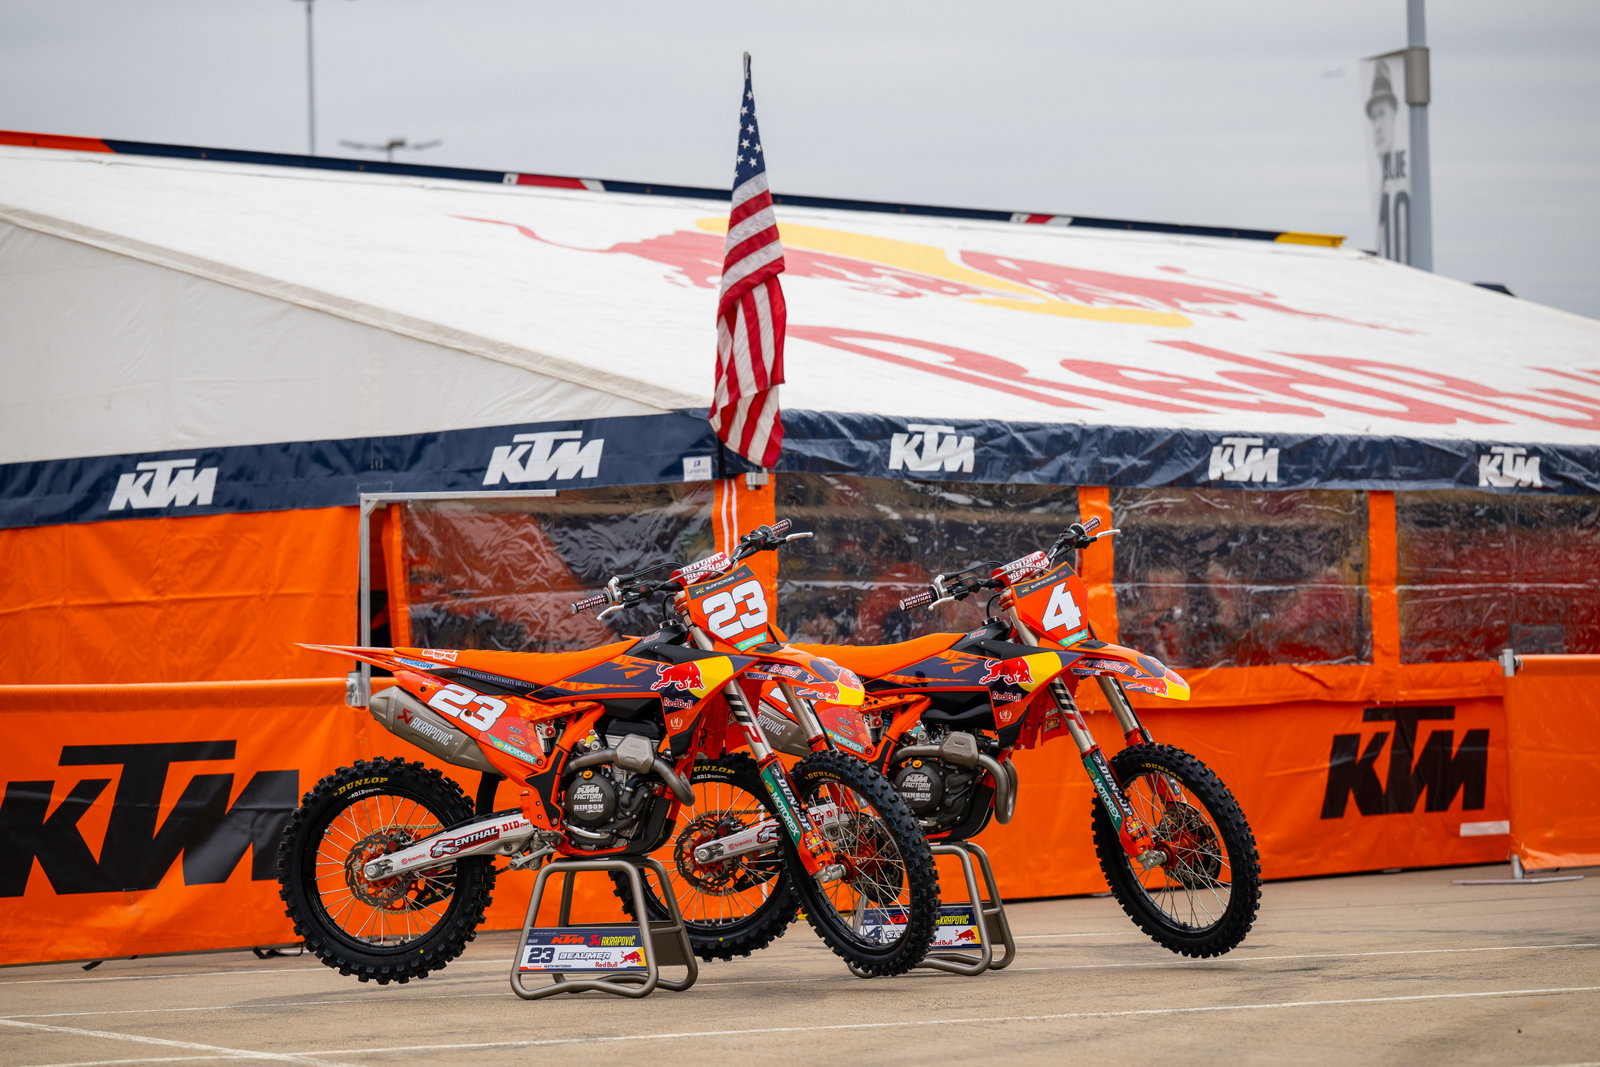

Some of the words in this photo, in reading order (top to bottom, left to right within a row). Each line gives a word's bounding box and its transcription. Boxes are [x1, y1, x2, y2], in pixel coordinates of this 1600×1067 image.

[482, 430, 604, 486] KTM
[889, 424, 975, 473] KTM
[1208, 437, 1279, 482] KTM
[1479, 446, 1543, 488] KTM
[108, 458, 218, 511] KTM
[702, 579, 768, 640] 23
[1042, 581, 1082, 632] 4
[457, 667, 472, 677] LOMA
[487, 674, 515, 686] UNIVERSITY
[515, 681, 535, 689] HEALTH
[427, 684, 508, 732] 23
[664, 696, 679, 707] Red
[678, 699, 694, 709] Bull
[992, 691, 1007, 701] Red
[1006, 693, 1022, 702] Bull
[503, 743, 535, 764] MOTOREX
[832, 734, 863, 752] MOTOREX
[693, 765, 736, 775] UNLOP
[904, 773, 929, 783] KTM
[1320, 705, 1490, 820] KTM
[338, 777, 389, 795] DUNLOP
[576, 785, 600, 794] KTM
[1094, 778, 1121, 821] MOTOREX
[0, 740, 299, 898] KTM
[771, 791, 801, 837] MOTOREX
[527, 947, 555, 963] 23
[551, 934, 585, 944] KTM
[558, 952, 612, 961] BEAUMER
